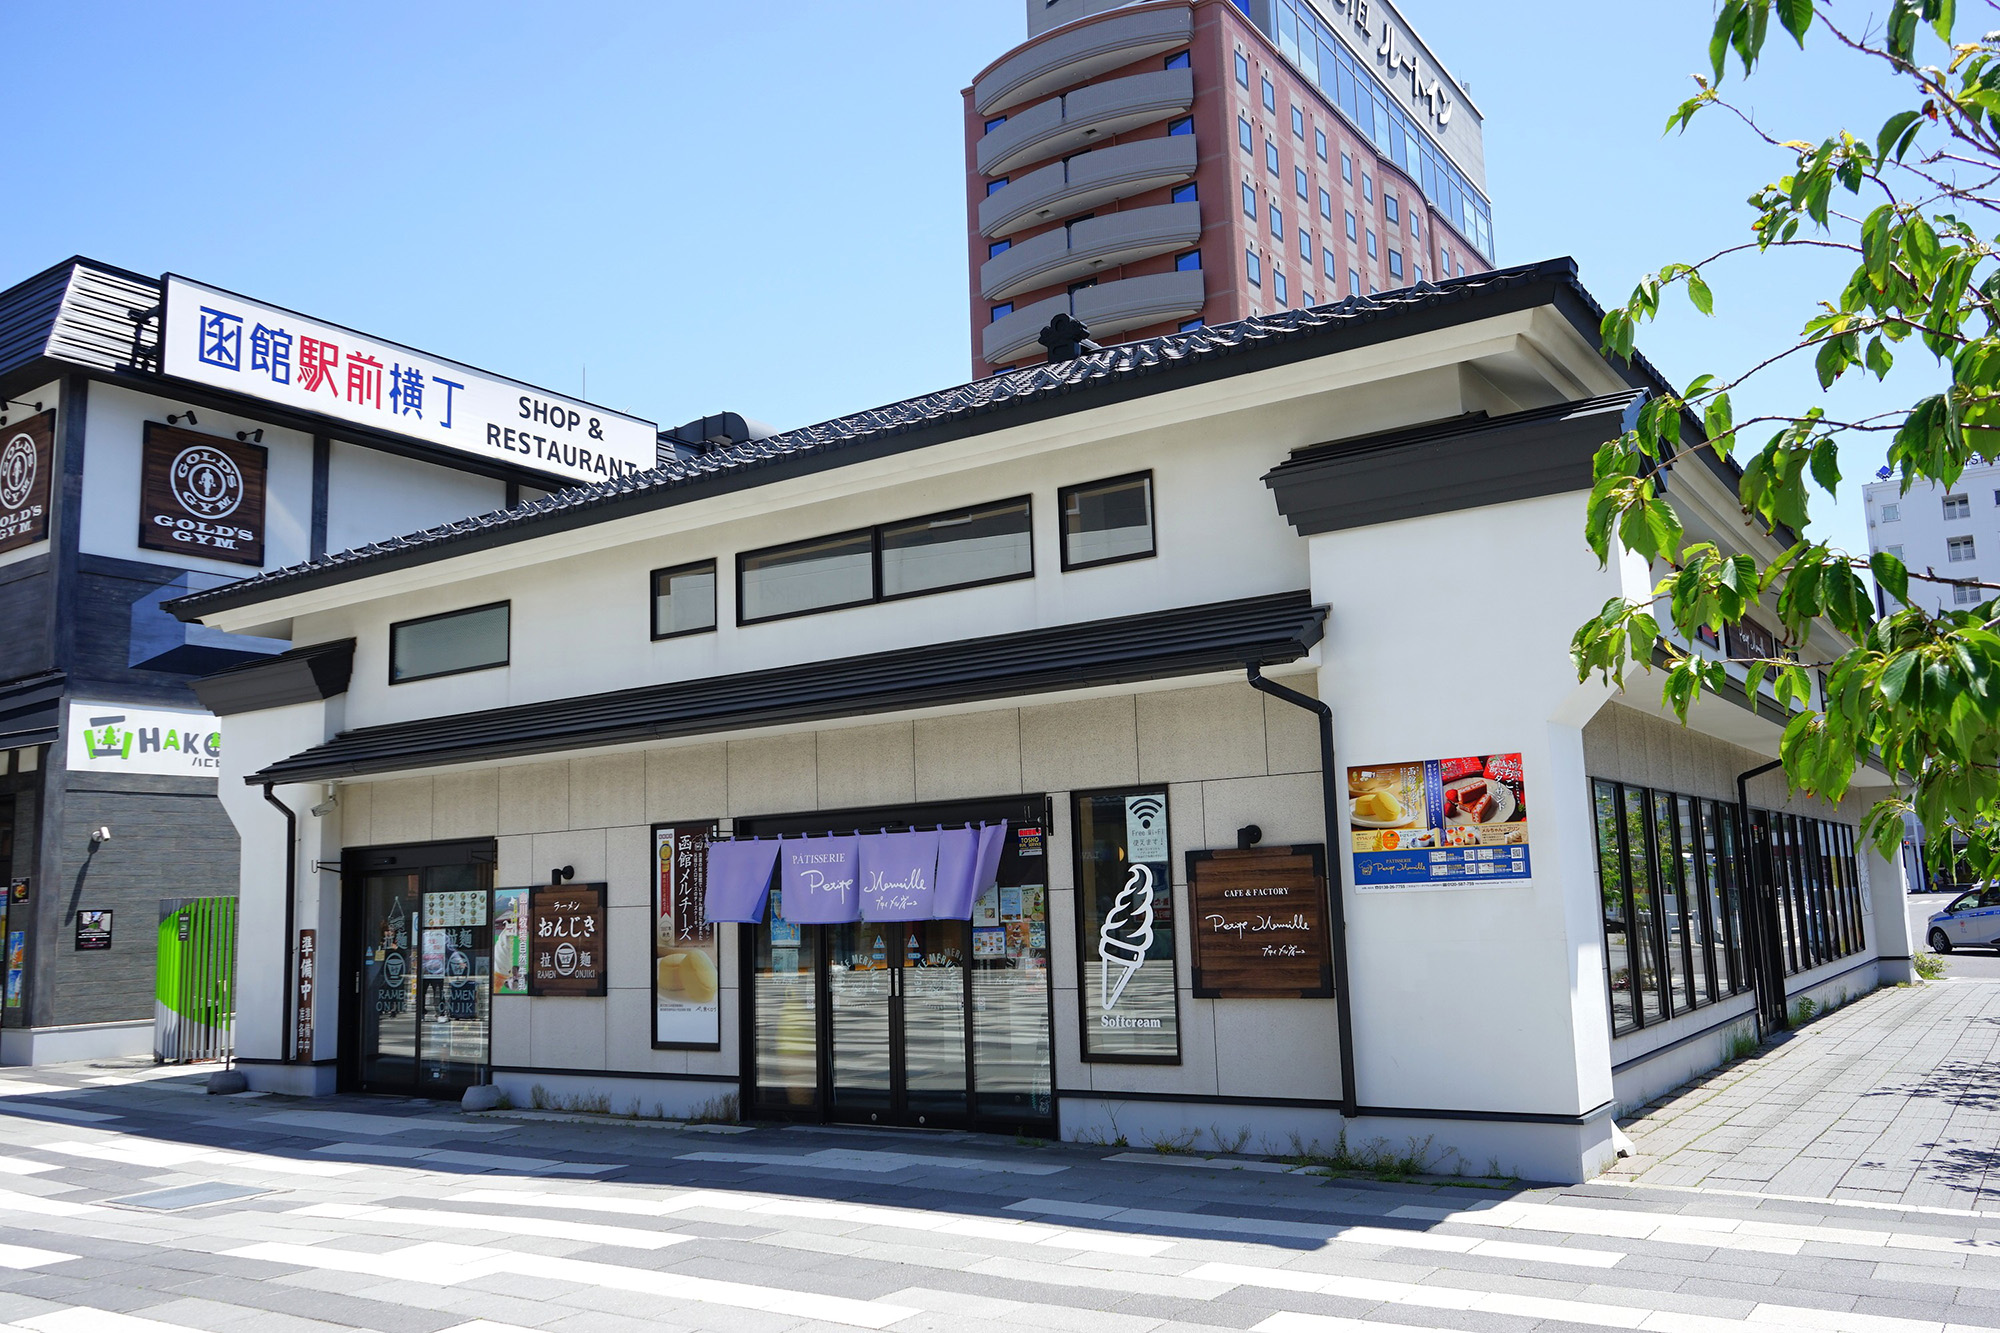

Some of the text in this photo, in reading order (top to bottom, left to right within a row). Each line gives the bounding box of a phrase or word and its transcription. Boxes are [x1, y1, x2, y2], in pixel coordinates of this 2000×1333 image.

[1378, 23, 1452, 125] ルートイン
[199, 306, 465, 429] 函館駅前横丁
[518, 396, 604, 442] SHOP &
[487, 423, 637, 477] RESTAURANT
[177, 451, 237, 488] GOLD'S
[182, 490, 235, 513] GYM
[153, 514, 254, 541] GOLD'S
[172, 530, 237, 549] GYM
[678, 834, 693, 941] 函館メルチーズ
[1224, 887, 1289, 897] CAFE & FACTORY
[553, 901, 580, 911] ラーメン
[538, 916, 595, 938] おんじき
[300, 935, 314, 1001] 準備中
[537, 969, 595, 979] RAMEN ONJIKI
[1100, 1014, 1161, 1028] Softcream
